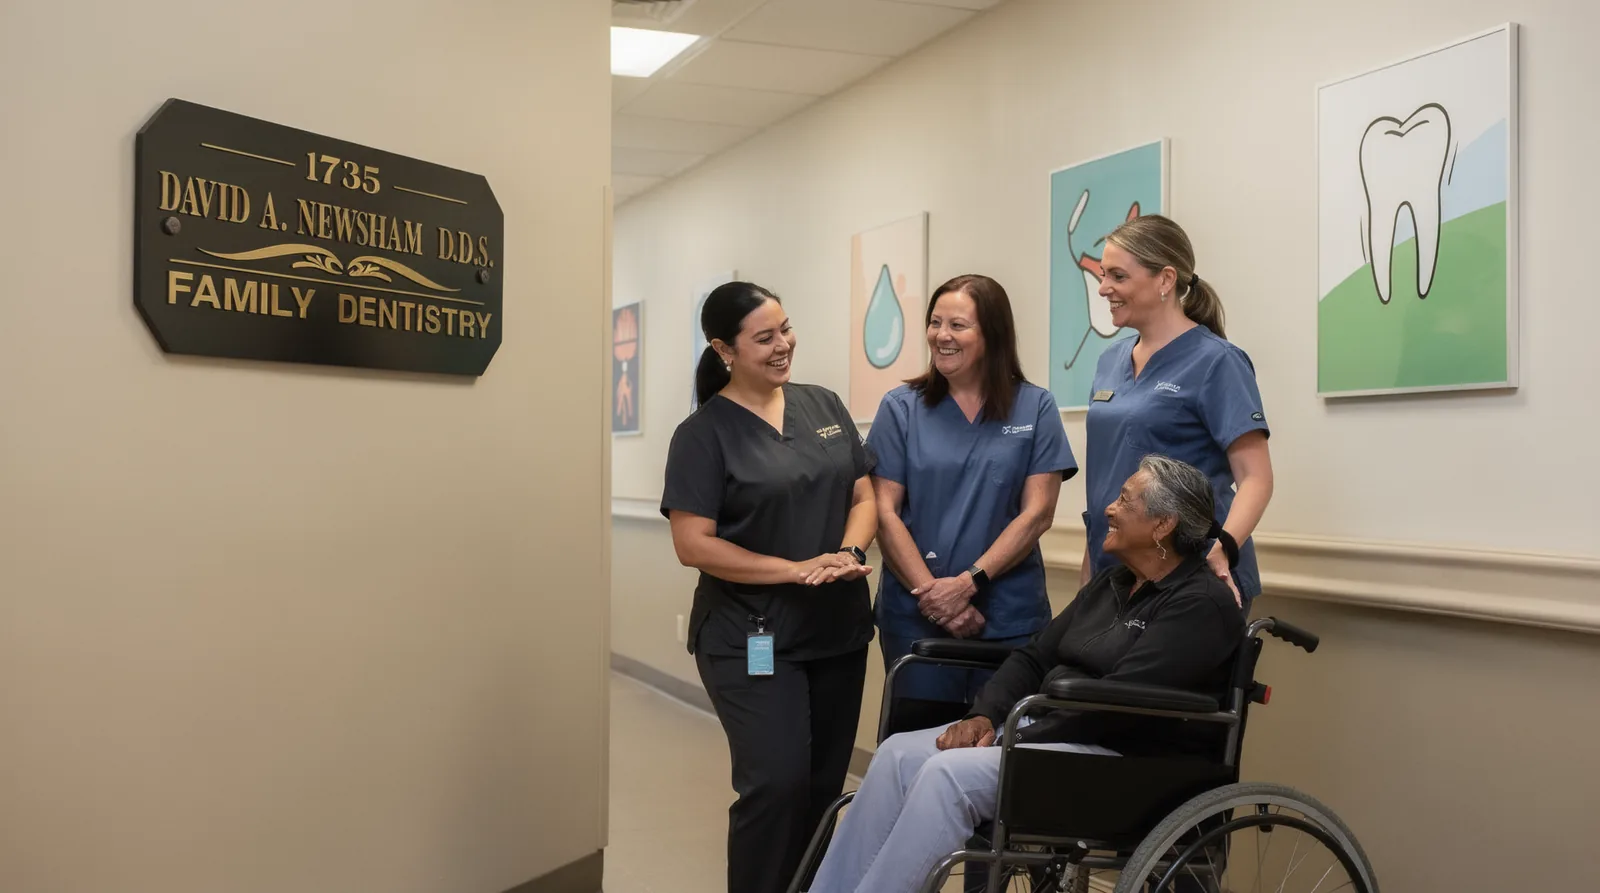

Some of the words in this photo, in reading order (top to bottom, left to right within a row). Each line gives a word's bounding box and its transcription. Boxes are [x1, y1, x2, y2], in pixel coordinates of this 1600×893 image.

[305, 151, 381, 195] 1735
[158, 170, 250, 225] DAVID
[259, 192, 288, 231] A.
[297, 198, 423, 256] NEWSHAM
[438, 227, 494, 268] D.D.S.
[167, 270, 316, 319] FAMILY
[338, 293, 492, 339] DENTISTRY
